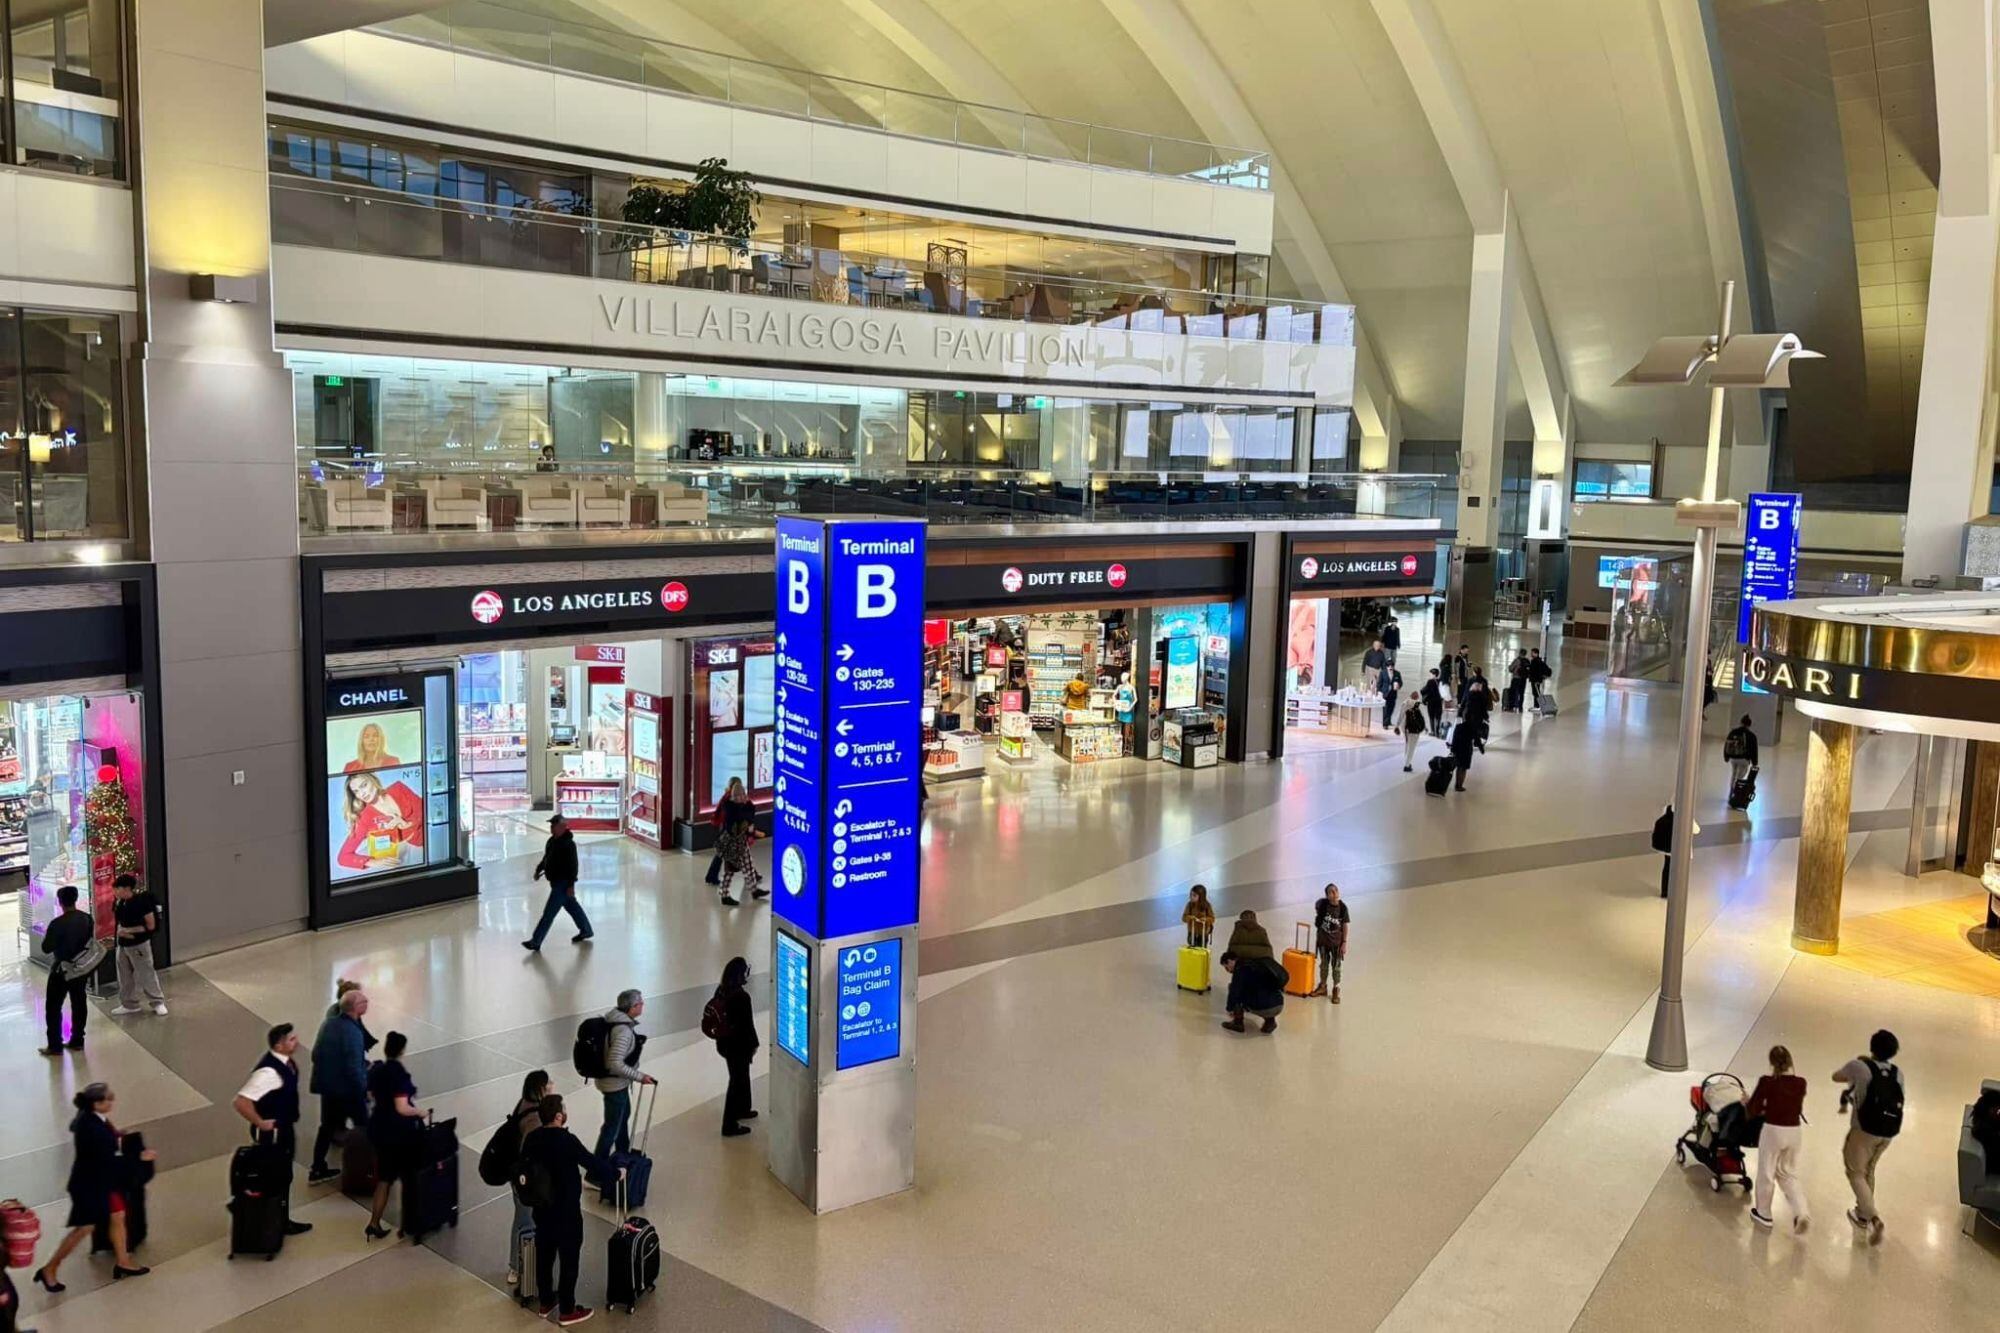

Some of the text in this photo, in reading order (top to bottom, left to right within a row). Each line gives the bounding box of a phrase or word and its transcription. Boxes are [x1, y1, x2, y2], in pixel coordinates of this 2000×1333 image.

[599, 294, 1086, 368] VILLARAIGOSA PAVILION
[1760, 508, 1780, 529] B
[780, 533, 819, 554] Terminal
[840, 537, 915, 556] Terminal
[1322, 560, 1397, 573] LOS ANGELES
[1028, 571, 1103, 586] DUTY FREE
[789, 559, 810, 615] B
[856, 563, 897, 619] B
[513, 591, 653, 613] LOS ANGELES
[663, 590, 688, 603] DFS
[853, 667, 884, 679] Gates
[853, 678, 895, 691] 130-235
[339, 688, 408, 706] CHANEL
[851, 740, 895, 754] Terminal
[851, 751, 902, 768] 4, 5, 6 & 7
[850, 819, 897, 832] Escalator to
[850, 831, 882, 843] Terminal
[850, 855, 873, 866] Gates
[849, 870, 888, 882] Restroom
[843, 965, 891, 983] Terminal B
[843, 979, 890, 996] Bag Claim
[842, 1020, 874, 1032] Escalator
[842, 1028, 870, 1041] Terminal
